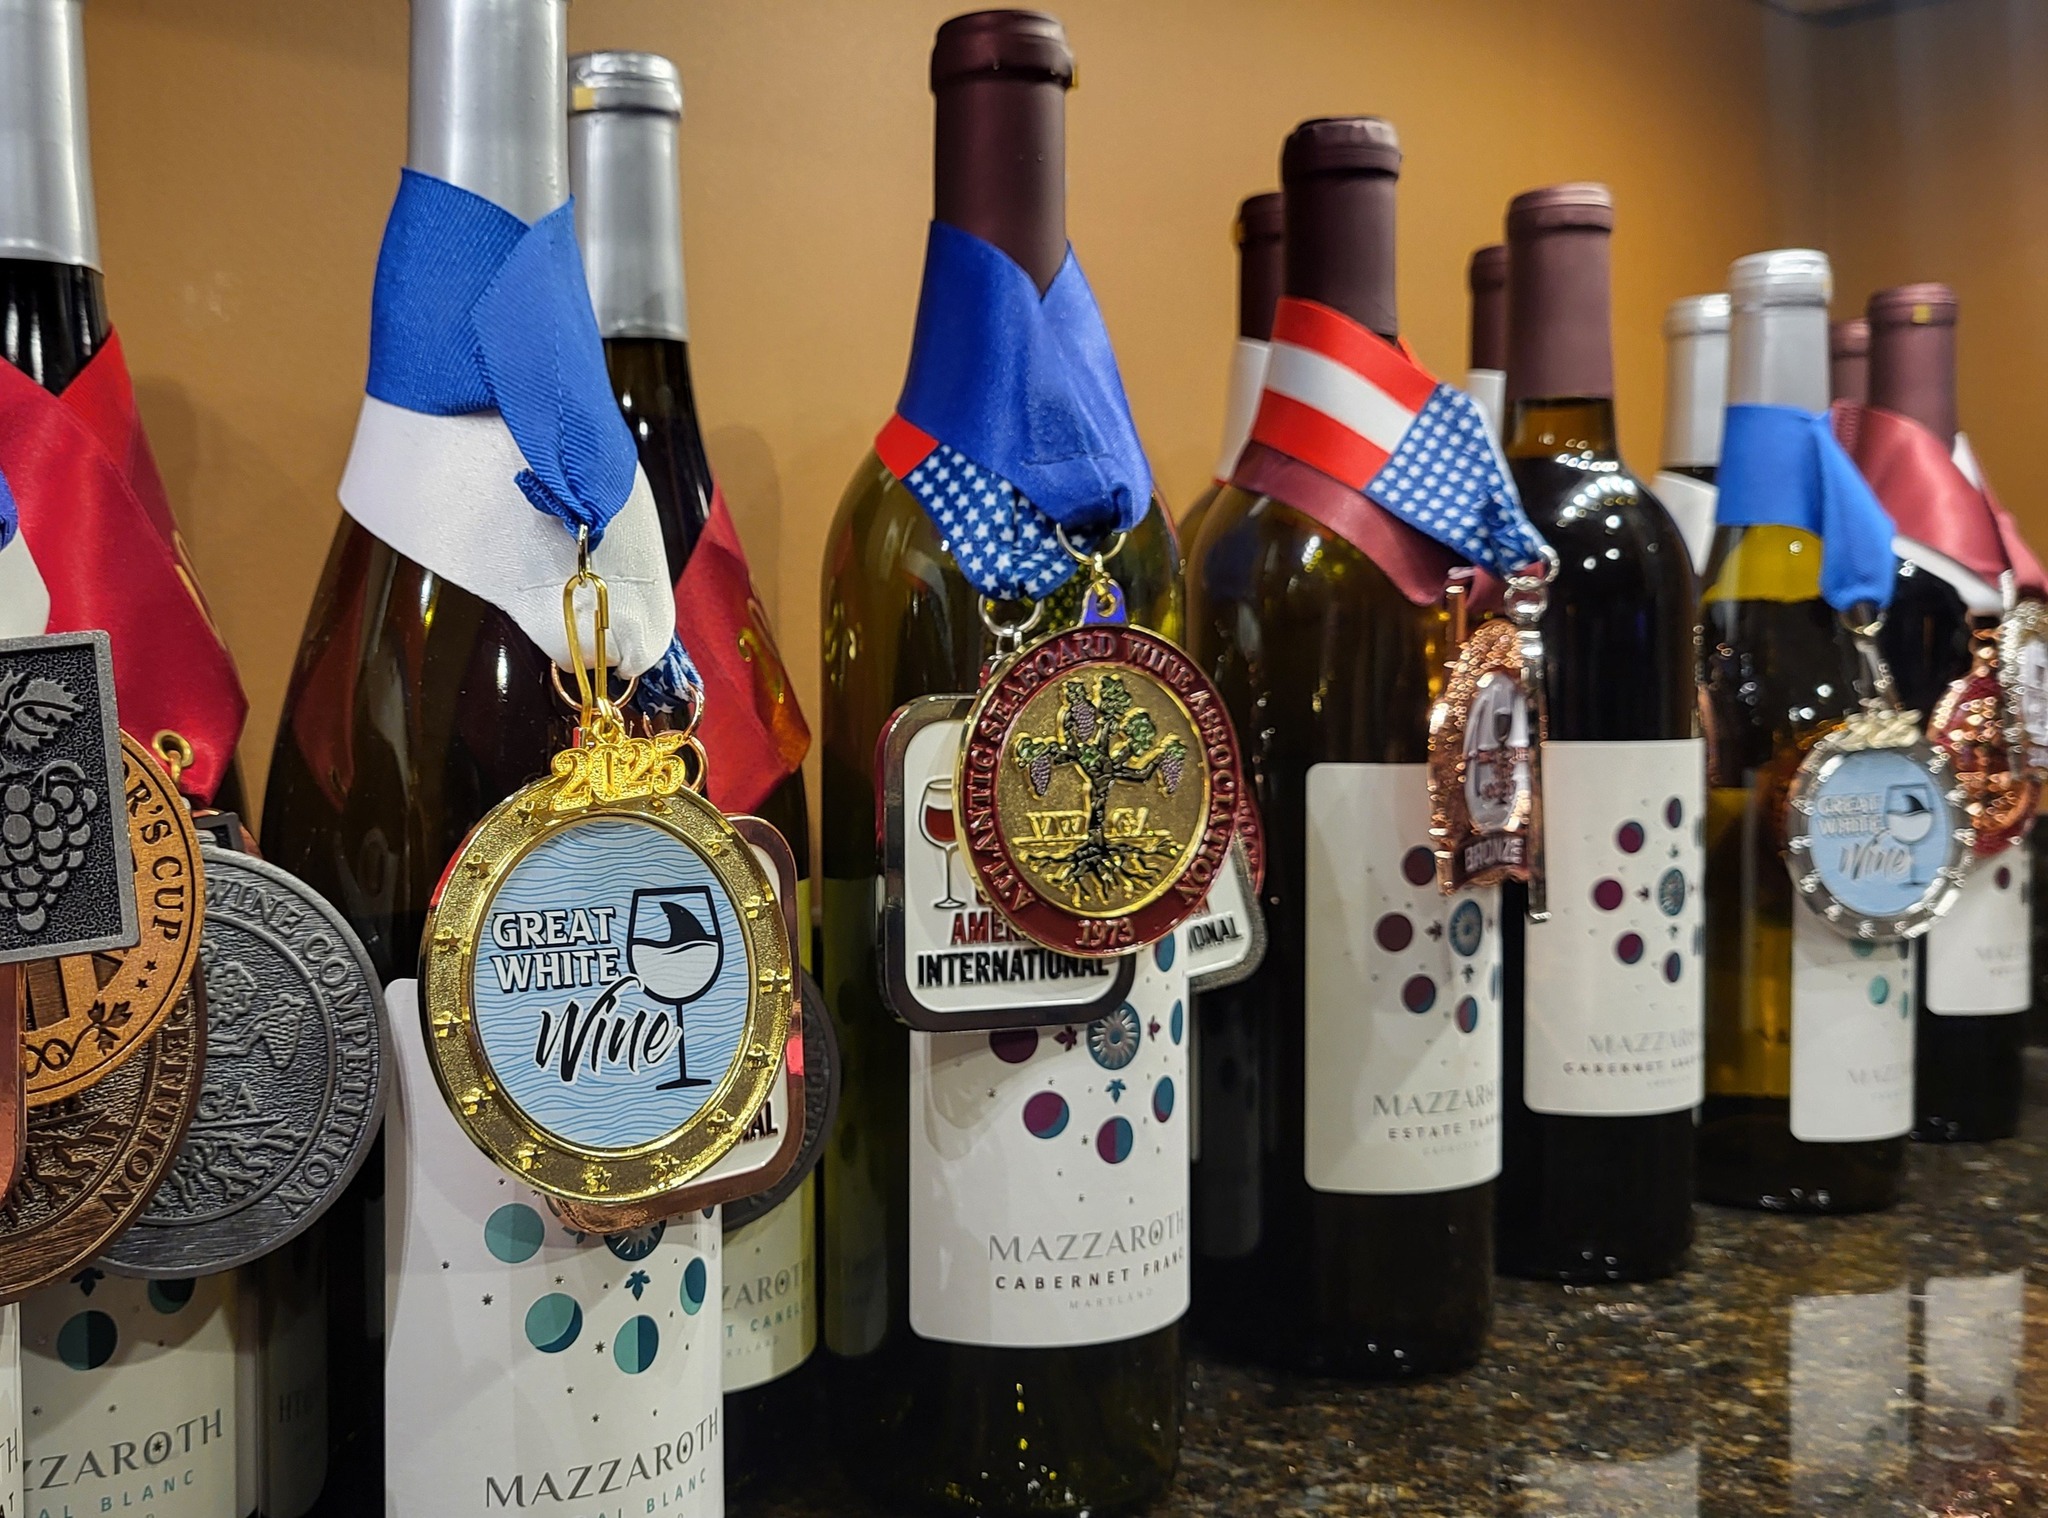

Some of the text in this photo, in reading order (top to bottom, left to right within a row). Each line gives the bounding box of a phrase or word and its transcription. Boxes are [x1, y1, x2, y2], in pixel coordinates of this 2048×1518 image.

[979, 629, 1117, 742] SEABOARD
[1121, 632, 1196, 693] WINE
[549, 732, 687, 812] 2025
[1174, 688, 1235, 907] ASSOCIATION
[966, 742, 1037, 911] ATLANTIC
[1464, 836, 1525, 873] BRONZE
[151, 855, 185, 942] CUP
[490, 906, 617, 952] GREAT
[1073, 917, 1136, 949] 1973
[489, 947, 623, 994] WHITE
[916, 945, 1111, 990] INTERNATIONAL
[534, 973, 683, 1085] Wine
[278, 930, 372, 1222] COMPETITION
[1387, 1122, 1462, 1140] ESTATE
[988, 1206, 1184, 1263] MAZZAROTH
[996, 1246, 1183, 1290] CABERNET FRANC
[486, 1406, 719, 1508] MAZZAROTH
[100, 1469, 194, 1512] BLANC
[646, 1467, 706, 1514] BLANC
